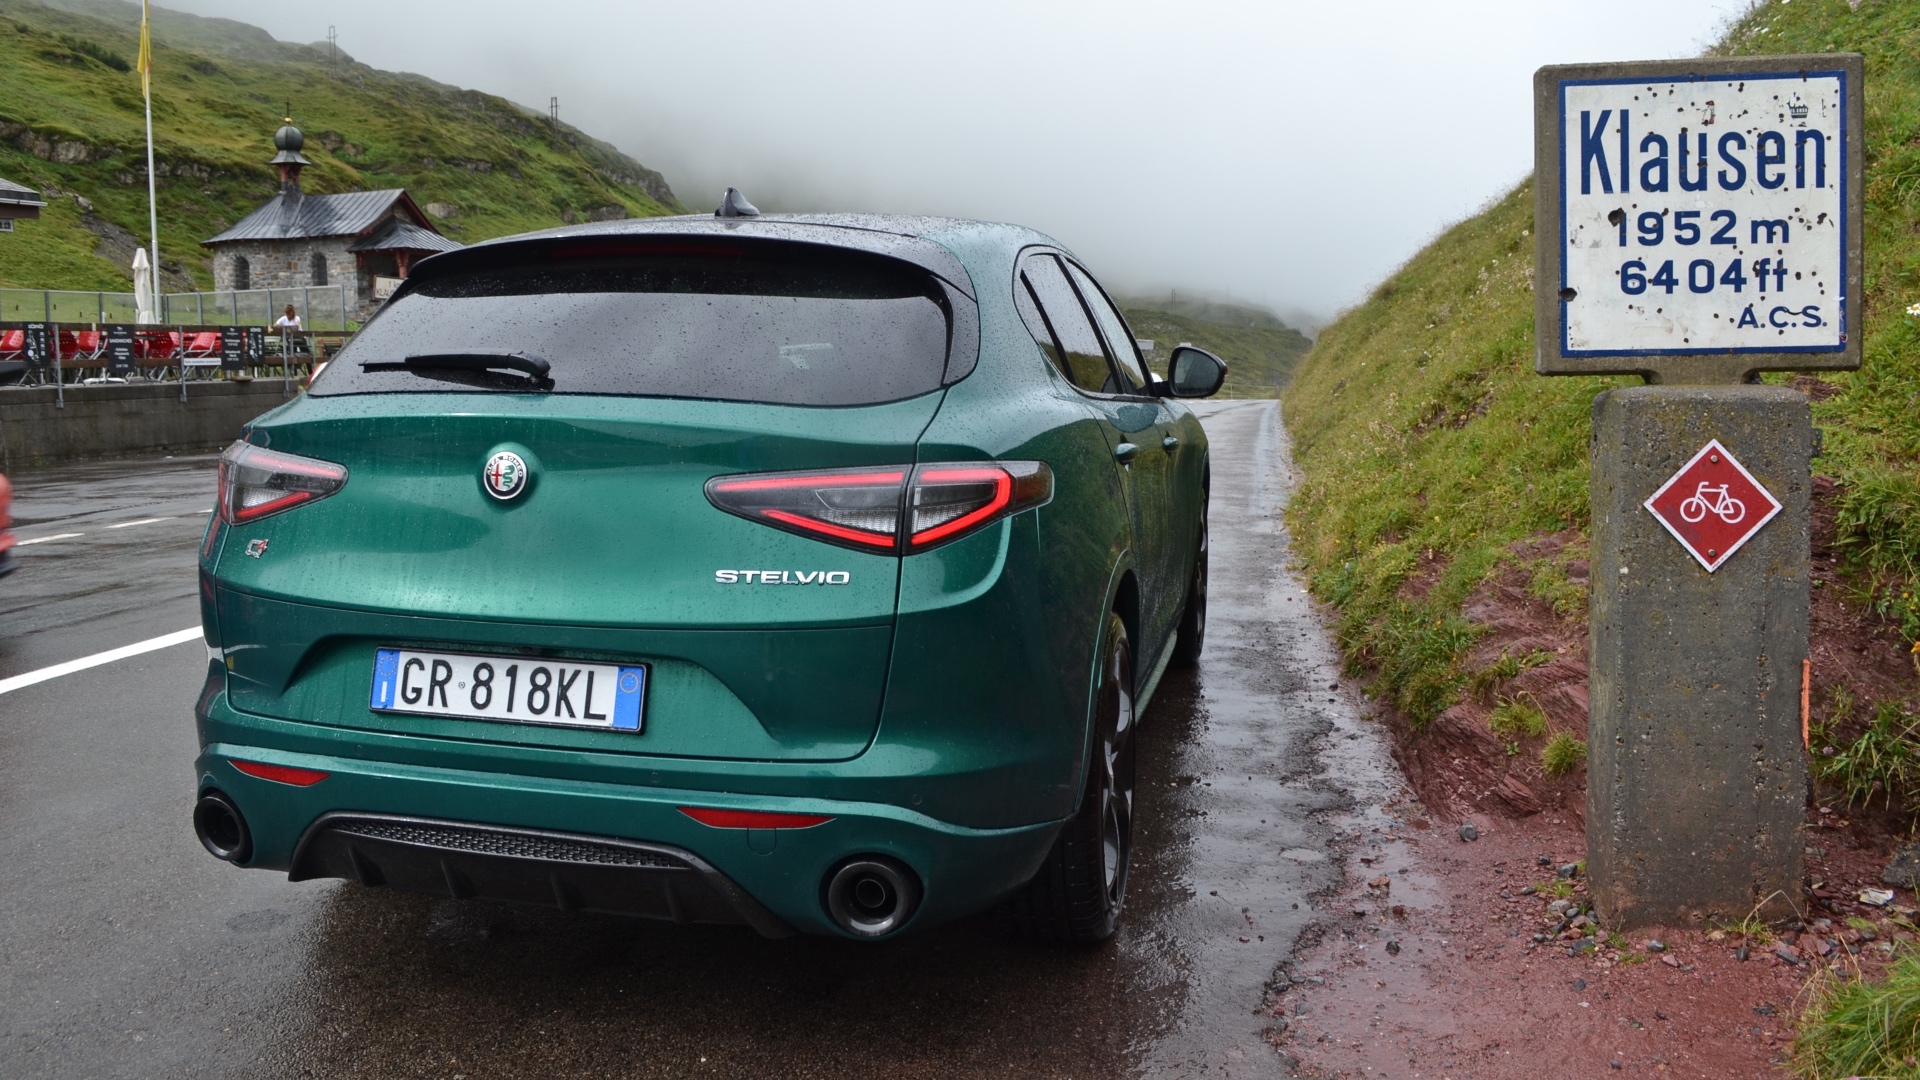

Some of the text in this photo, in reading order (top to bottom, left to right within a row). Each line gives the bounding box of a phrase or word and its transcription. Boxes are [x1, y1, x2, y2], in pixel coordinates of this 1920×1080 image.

[1580, 108, 1826, 195] Klausen
[1617, 209, 1790, 247] 1952 m
[1736, 305, 1828, 329] A.C.S.
[714, 569, 851, 586] STELVIO
